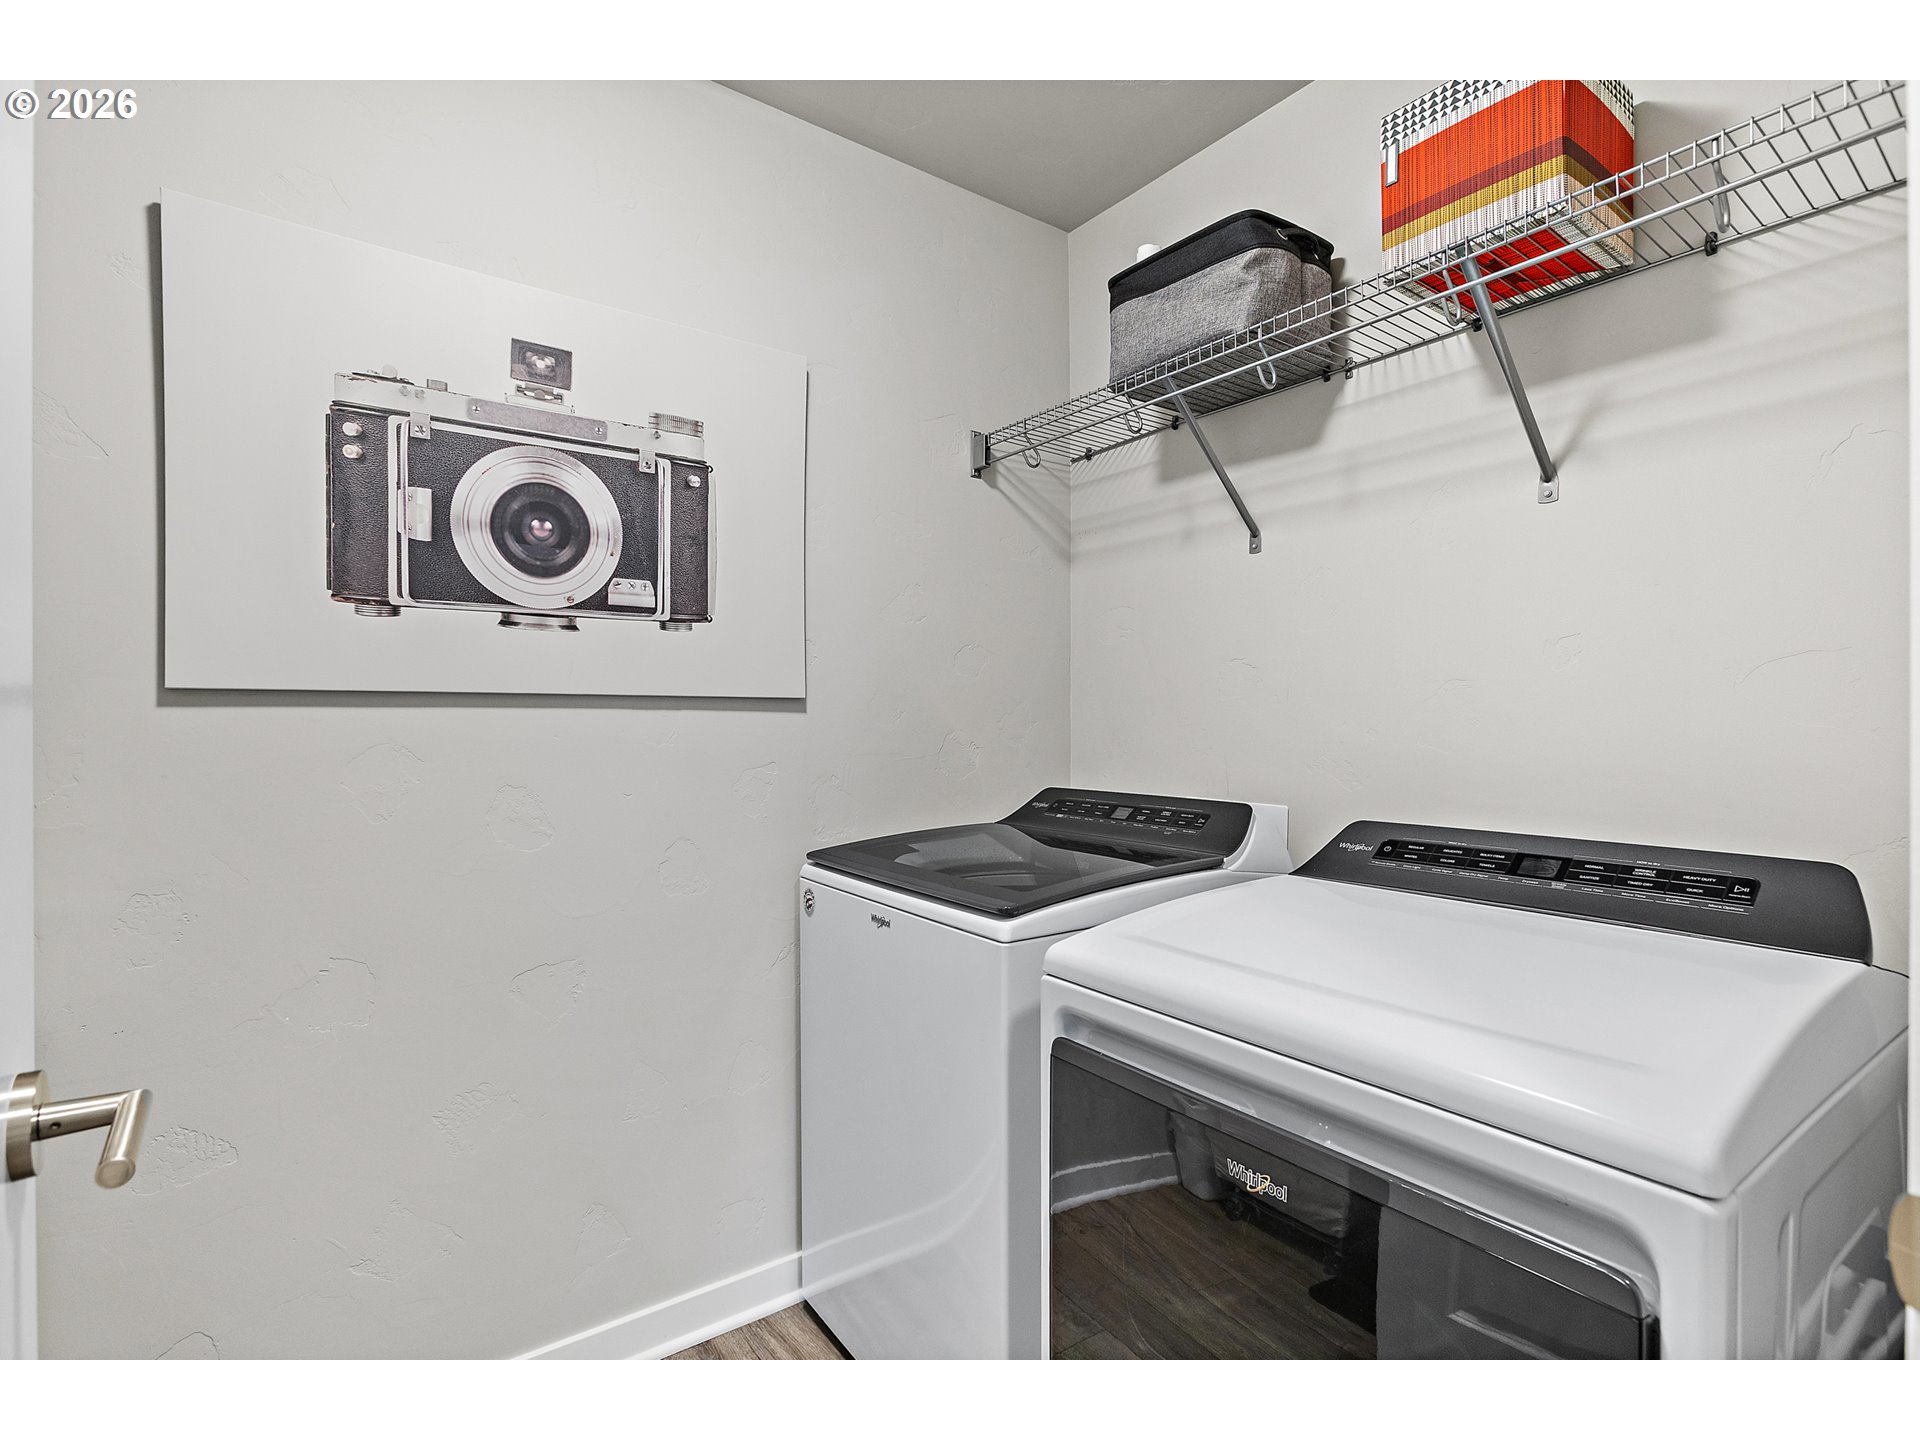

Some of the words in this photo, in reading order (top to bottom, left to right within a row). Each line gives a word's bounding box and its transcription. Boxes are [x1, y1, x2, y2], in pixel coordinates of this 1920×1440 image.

[1339, 842, 1374, 852] Whirlpool
[870, 913, 891, 928] Whirlpool
[1226, 1158, 1288, 1203] Whirlpool
